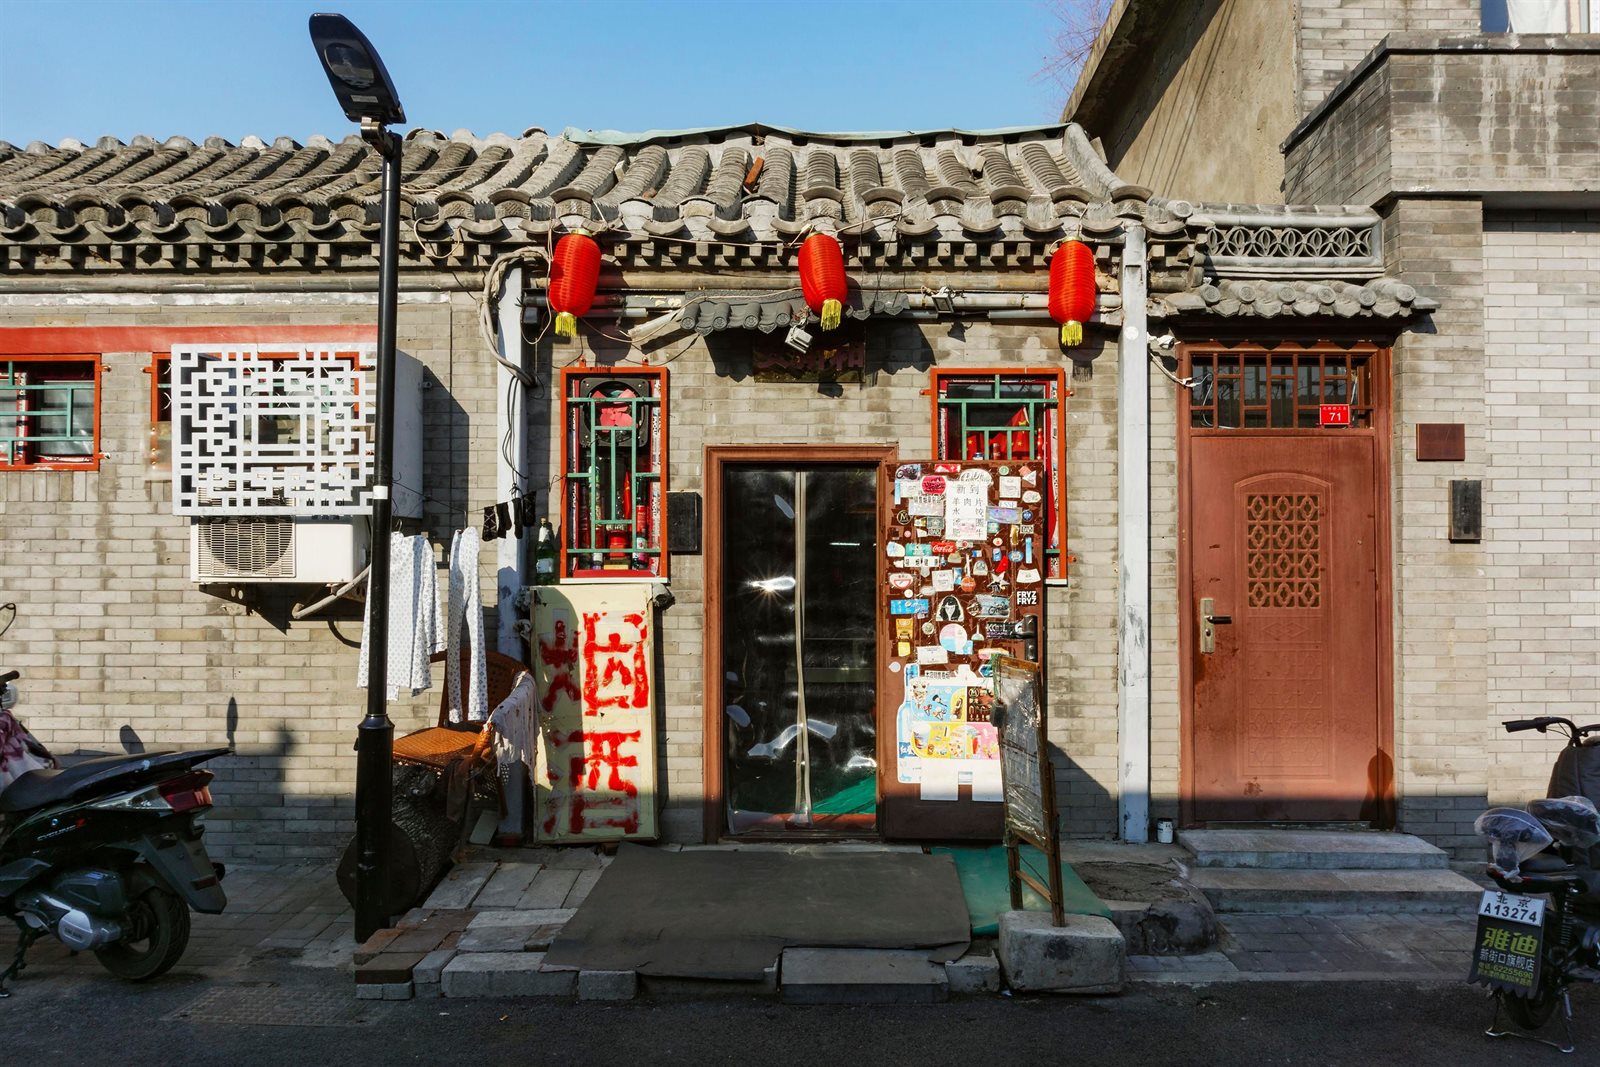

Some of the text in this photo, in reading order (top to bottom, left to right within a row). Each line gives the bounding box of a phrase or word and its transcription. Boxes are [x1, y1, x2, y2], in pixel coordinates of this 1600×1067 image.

[1329, 412, 1341, 422] 71
[1496, 893, 1531, 908] 北京
[1484, 903, 1537, 922] A13274
[1482, 927, 1538, 957] 雅迪
[1480, 948, 1535, 971] 新街口旗舰店
